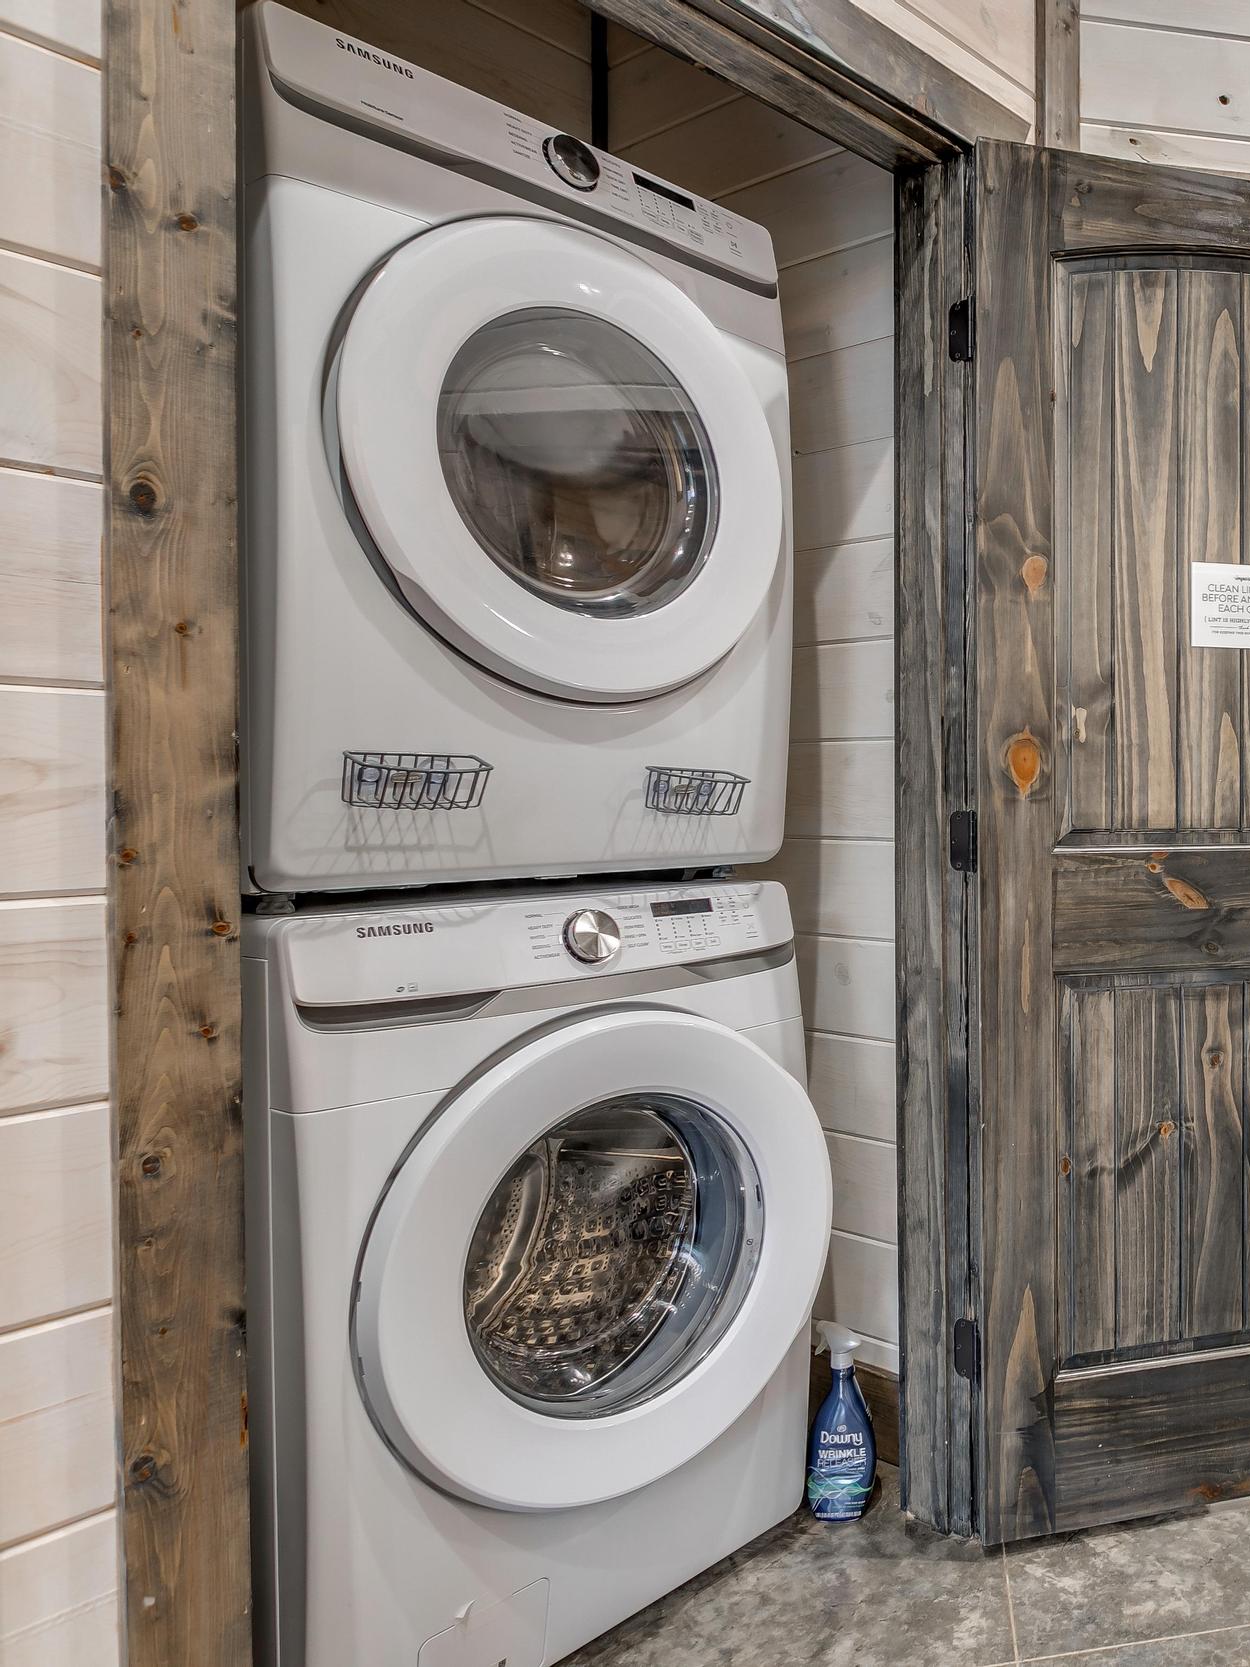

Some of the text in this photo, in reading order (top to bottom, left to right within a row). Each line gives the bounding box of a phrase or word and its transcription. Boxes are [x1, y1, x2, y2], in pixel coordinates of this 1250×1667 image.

[336, 38, 414, 79] SAMSUNG
[1207, 584, 1239, 593] CLEAN
[1202, 593, 1239, 603] BEFORE
[1218, 604, 1244, 613] EACH
[356, 922, 434, 939] SAMSUNG
[820, 1431, 863, 1446] Downy
[818, 1447, 867, 1459] WRINKLE
[817, 1456, 867, 1469] RELEASER
